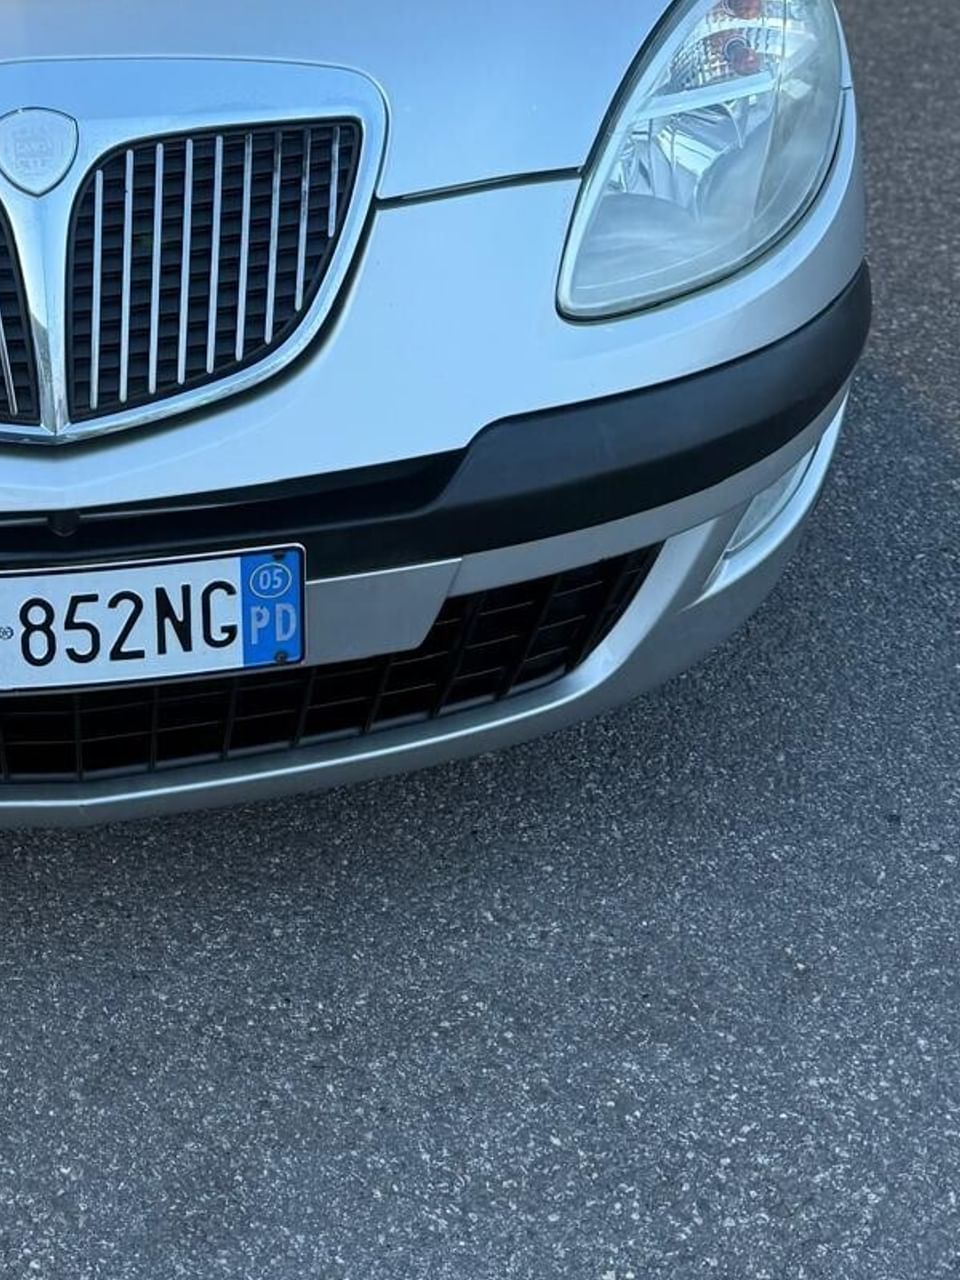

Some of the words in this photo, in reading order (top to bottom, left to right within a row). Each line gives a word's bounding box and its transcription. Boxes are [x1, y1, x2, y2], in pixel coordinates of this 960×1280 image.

[259, 571, 283, 590] 05
[19, 581, 238, 667] 852NG
[249, 603, 297, 645] PD
